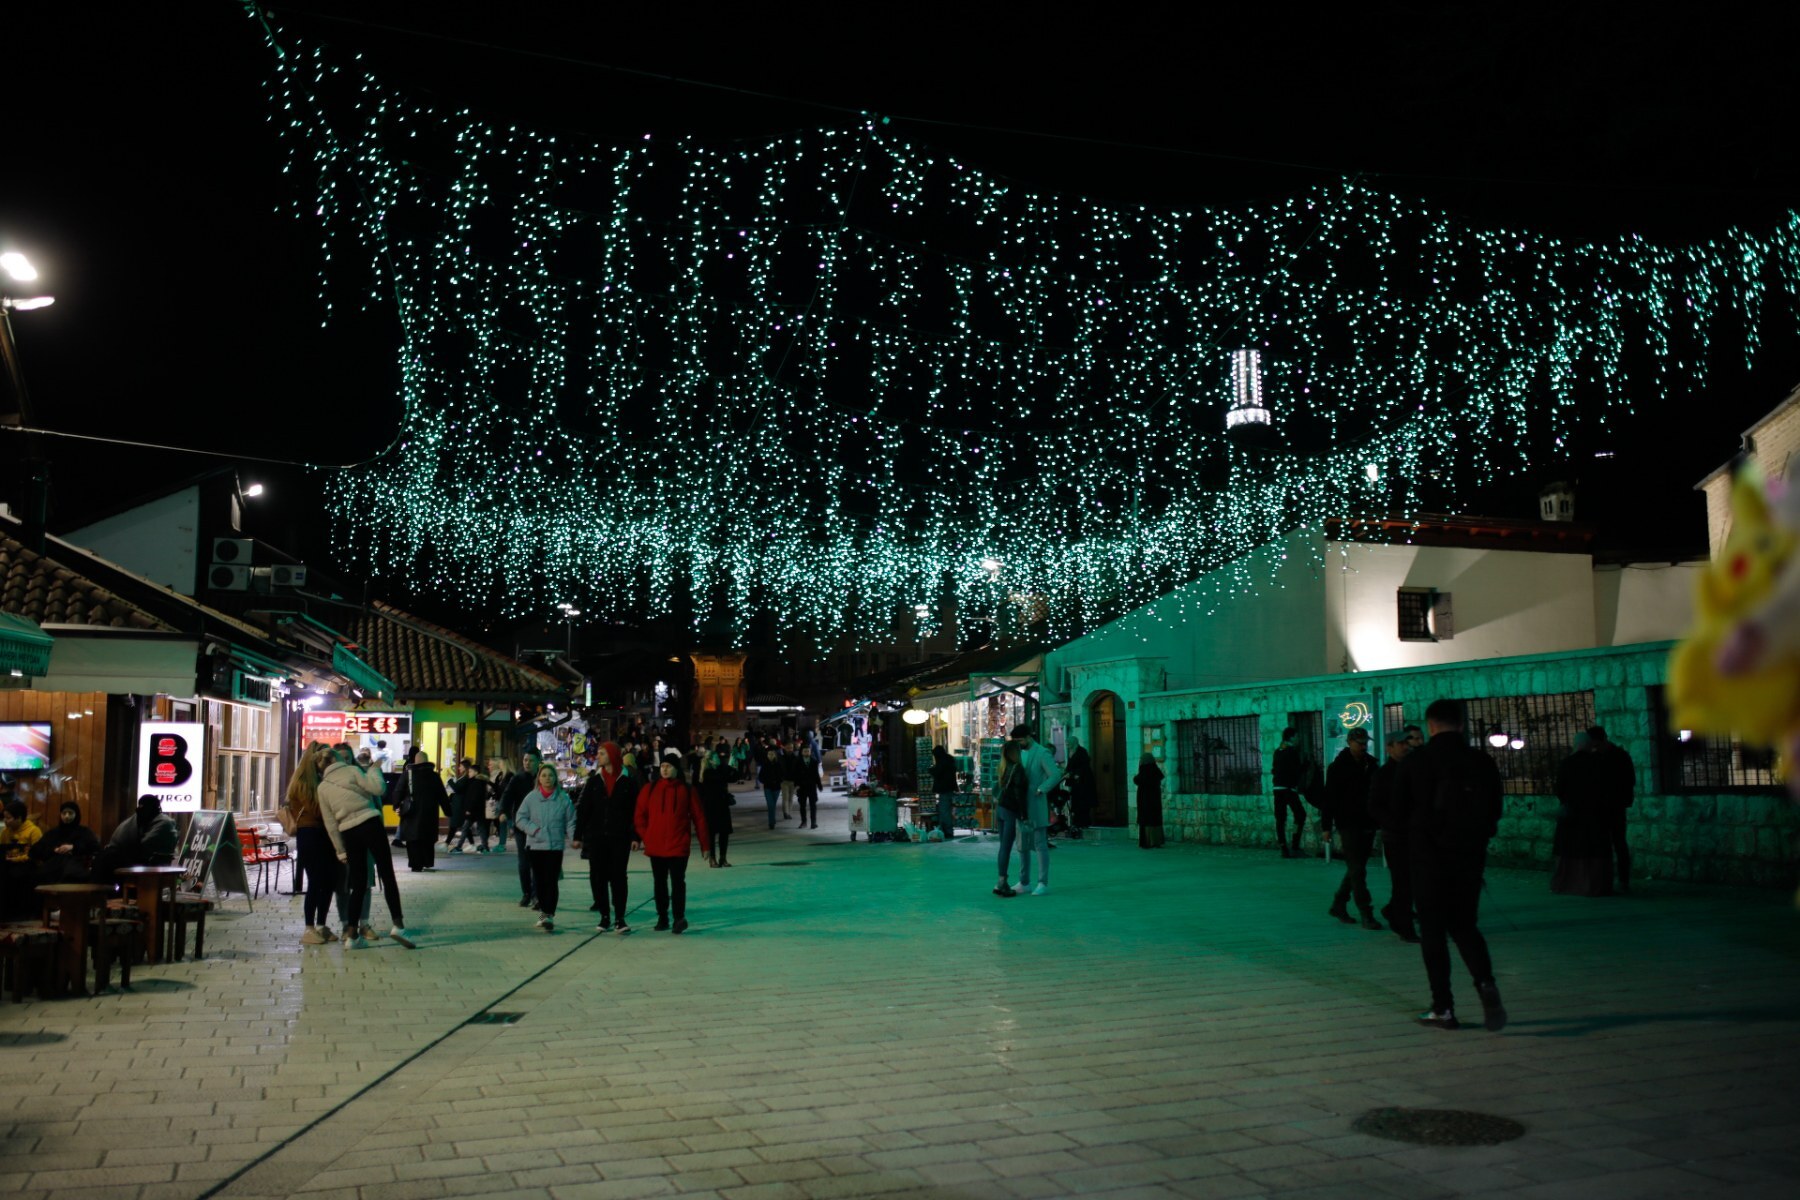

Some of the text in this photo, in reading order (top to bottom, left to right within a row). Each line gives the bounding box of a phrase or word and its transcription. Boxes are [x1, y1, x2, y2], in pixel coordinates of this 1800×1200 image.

[148, 733, 193, 787] B
[154, 794, 192, 802] URGO
[191, 830, 210, 852] ČAJ
